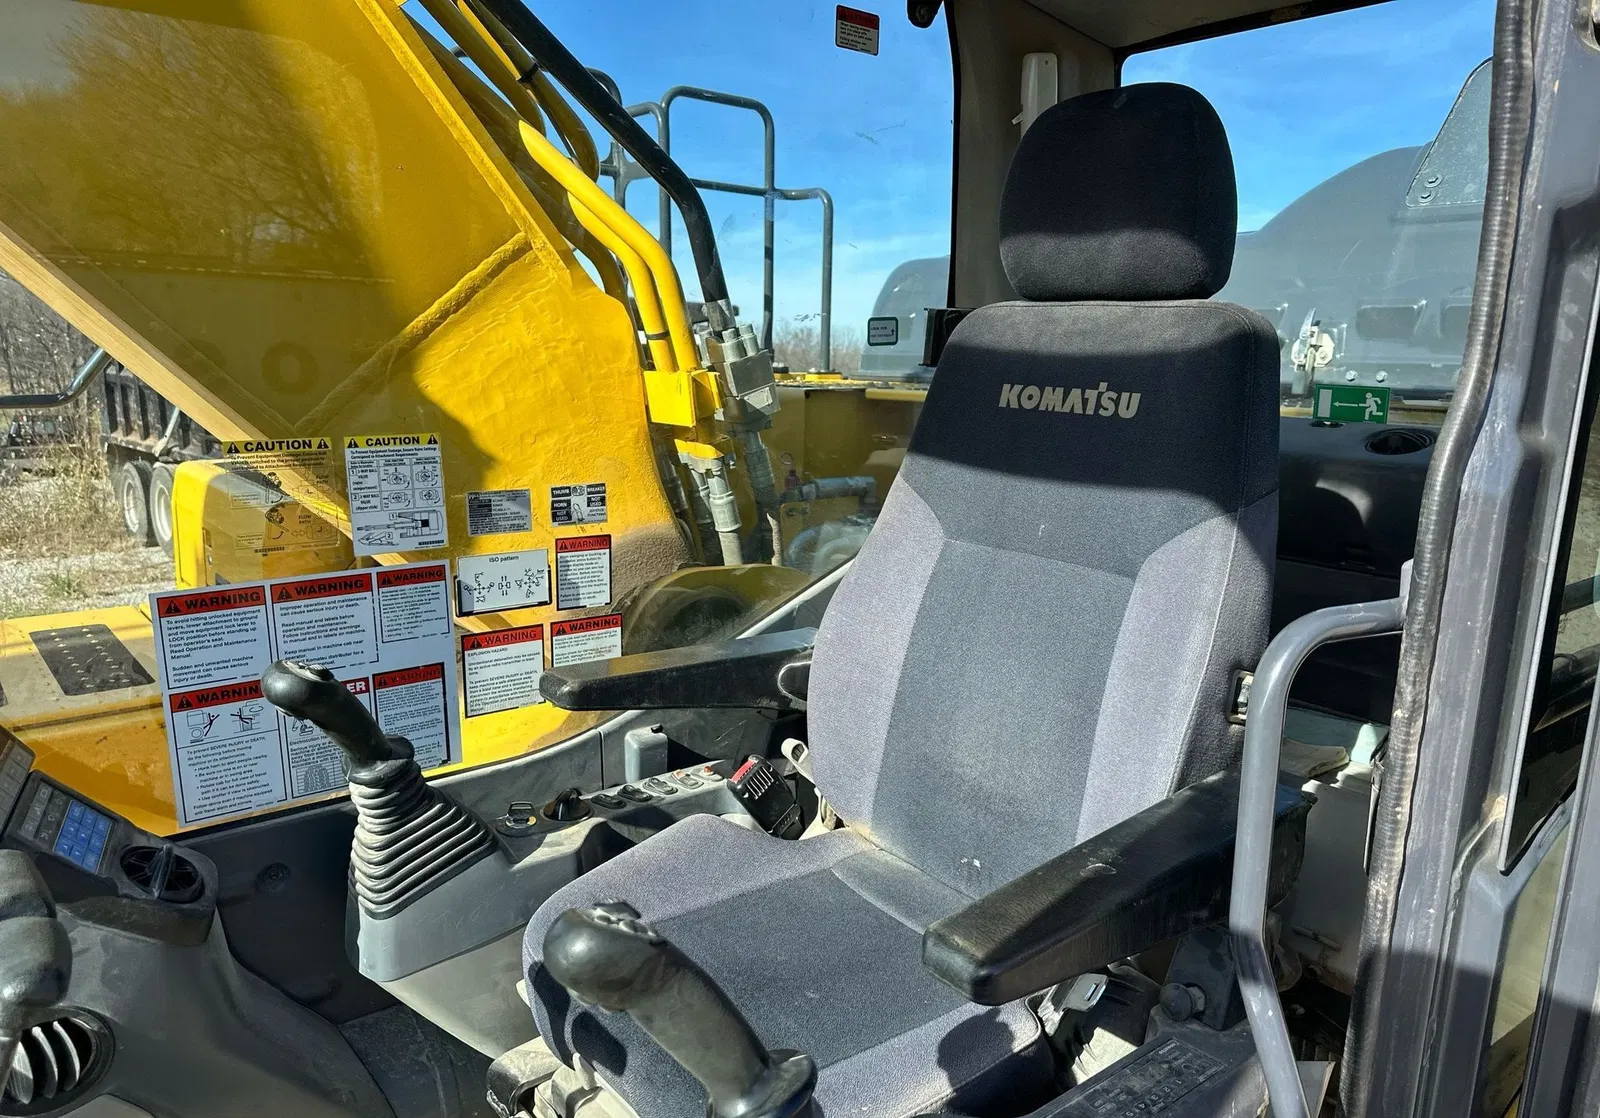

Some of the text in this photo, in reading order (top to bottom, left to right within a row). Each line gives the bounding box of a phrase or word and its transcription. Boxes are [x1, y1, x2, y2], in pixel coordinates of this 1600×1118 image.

[999, 382, 1141, 419] KOMATSU
[244, 440, 312, 452] CAUTION
[366, 436, 420, 447] CAUTION
[569, 539, 608, 549] WARNING
[394, 570, 443, 582] WARNING
[295, 579, 364, 596] WARNING
[185, 592, 261, 610] WARNING
[280, 604, 302, 612] Improper
[303, 601, 326, 609] operation
[233, 609, 261, 617] equipment
[167, 624, 185, 632] levers,
[202, 618, 232, 626] attachment
[195, 625, 223, 634] equipment
[282, 626, 306, 634] operation
[569, 618, 618, 632] WARNING
[186, 633, 208, 641] position
[226, 627, 249, 635] standing
[300, 628, 328, 636] instructions
[485, 630, 537, 645] WARNING
[183, 639, 210, 647] operator's
[185, 644, 212, 653] Operation
[224, 638, 257, 646] Maintenance
[205, 658, 231, 666] unwanted
[173, 669, 202, 677] movement
[196, 684, 259, 704] WARNIN
[193, 747, 209, 755] prevent
[202, 751, 221, 759] following
